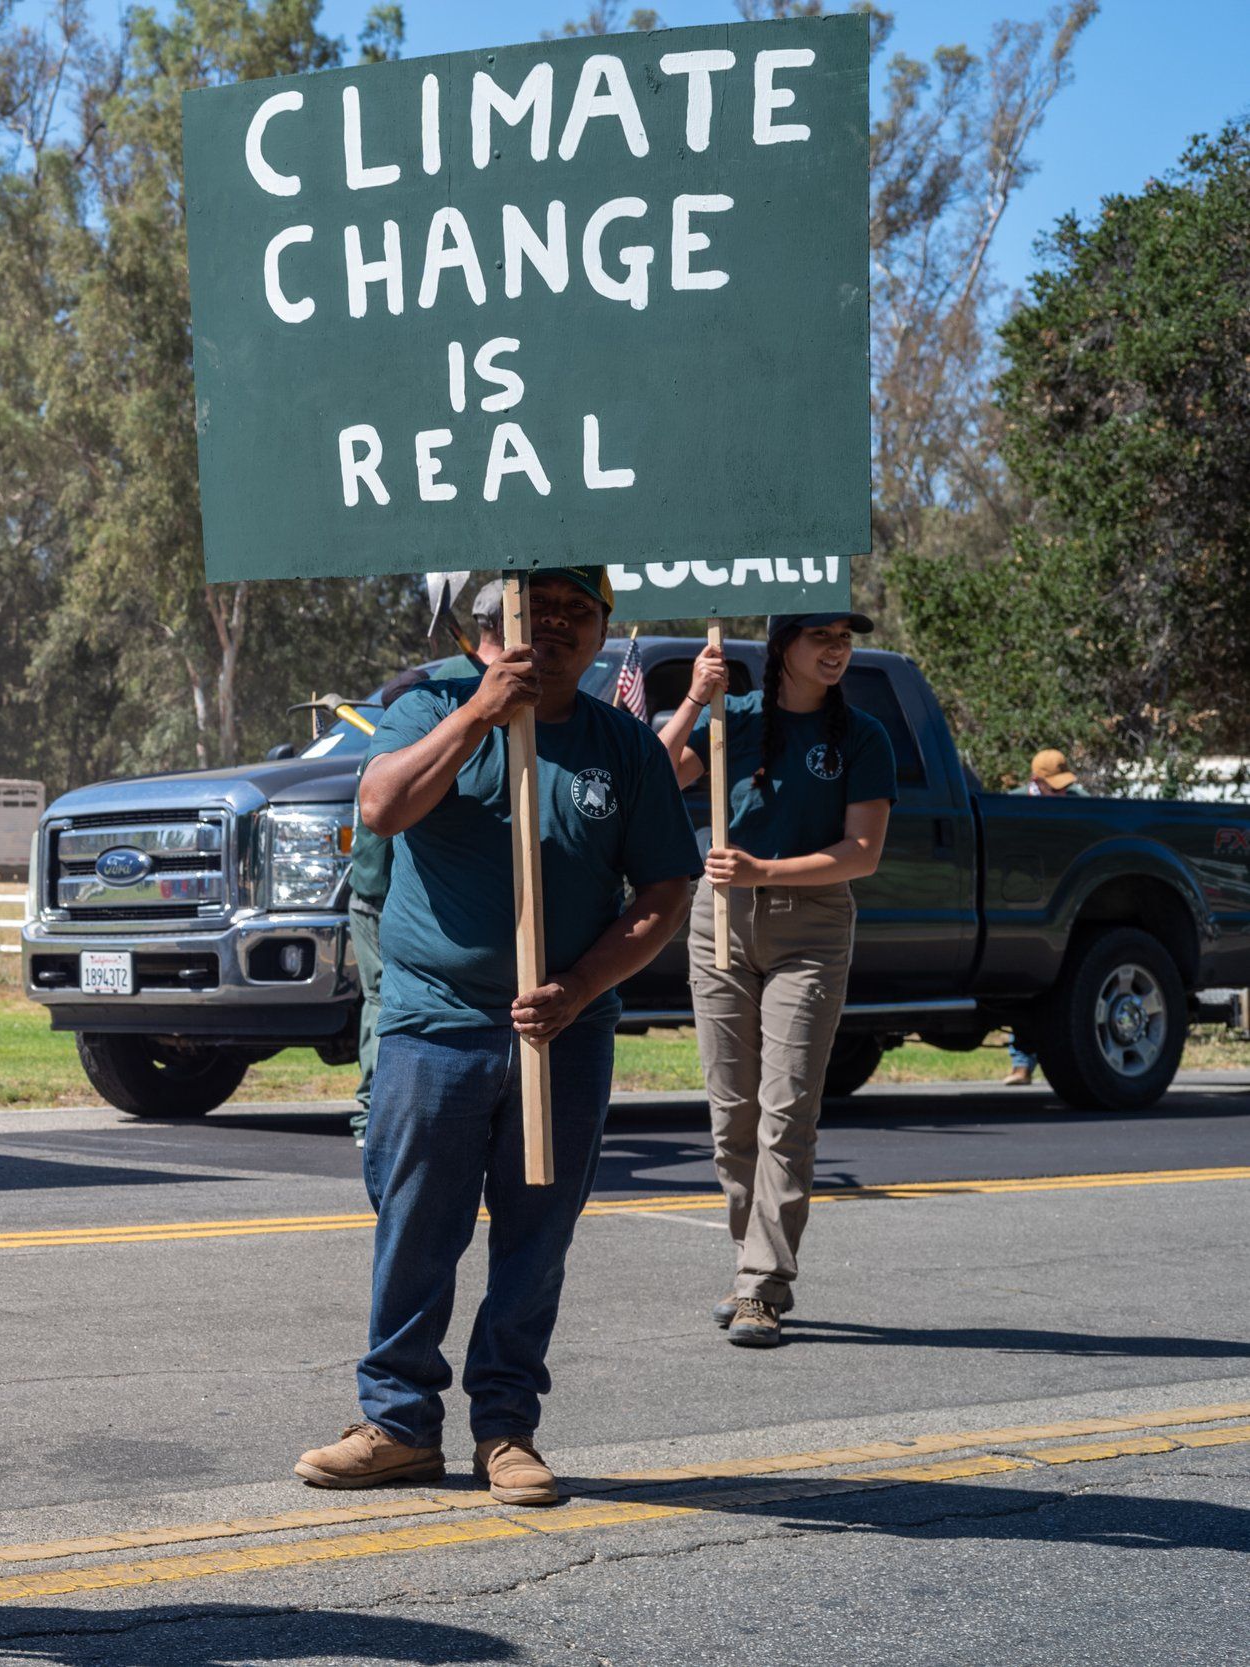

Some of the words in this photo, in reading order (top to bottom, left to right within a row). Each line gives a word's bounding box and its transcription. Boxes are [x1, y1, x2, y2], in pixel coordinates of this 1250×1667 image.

[245, 48, 816, 197] CLIMATE
[263, 194, 735, 324] CHANGE
[448, 336, 525, 413] IS
[338, 413, 636, 508] REAL
[104, 855, 133, 875] Ford
[1214, 828, 1250, 849] FX
[85, 967, 128, 987] 18943T2
